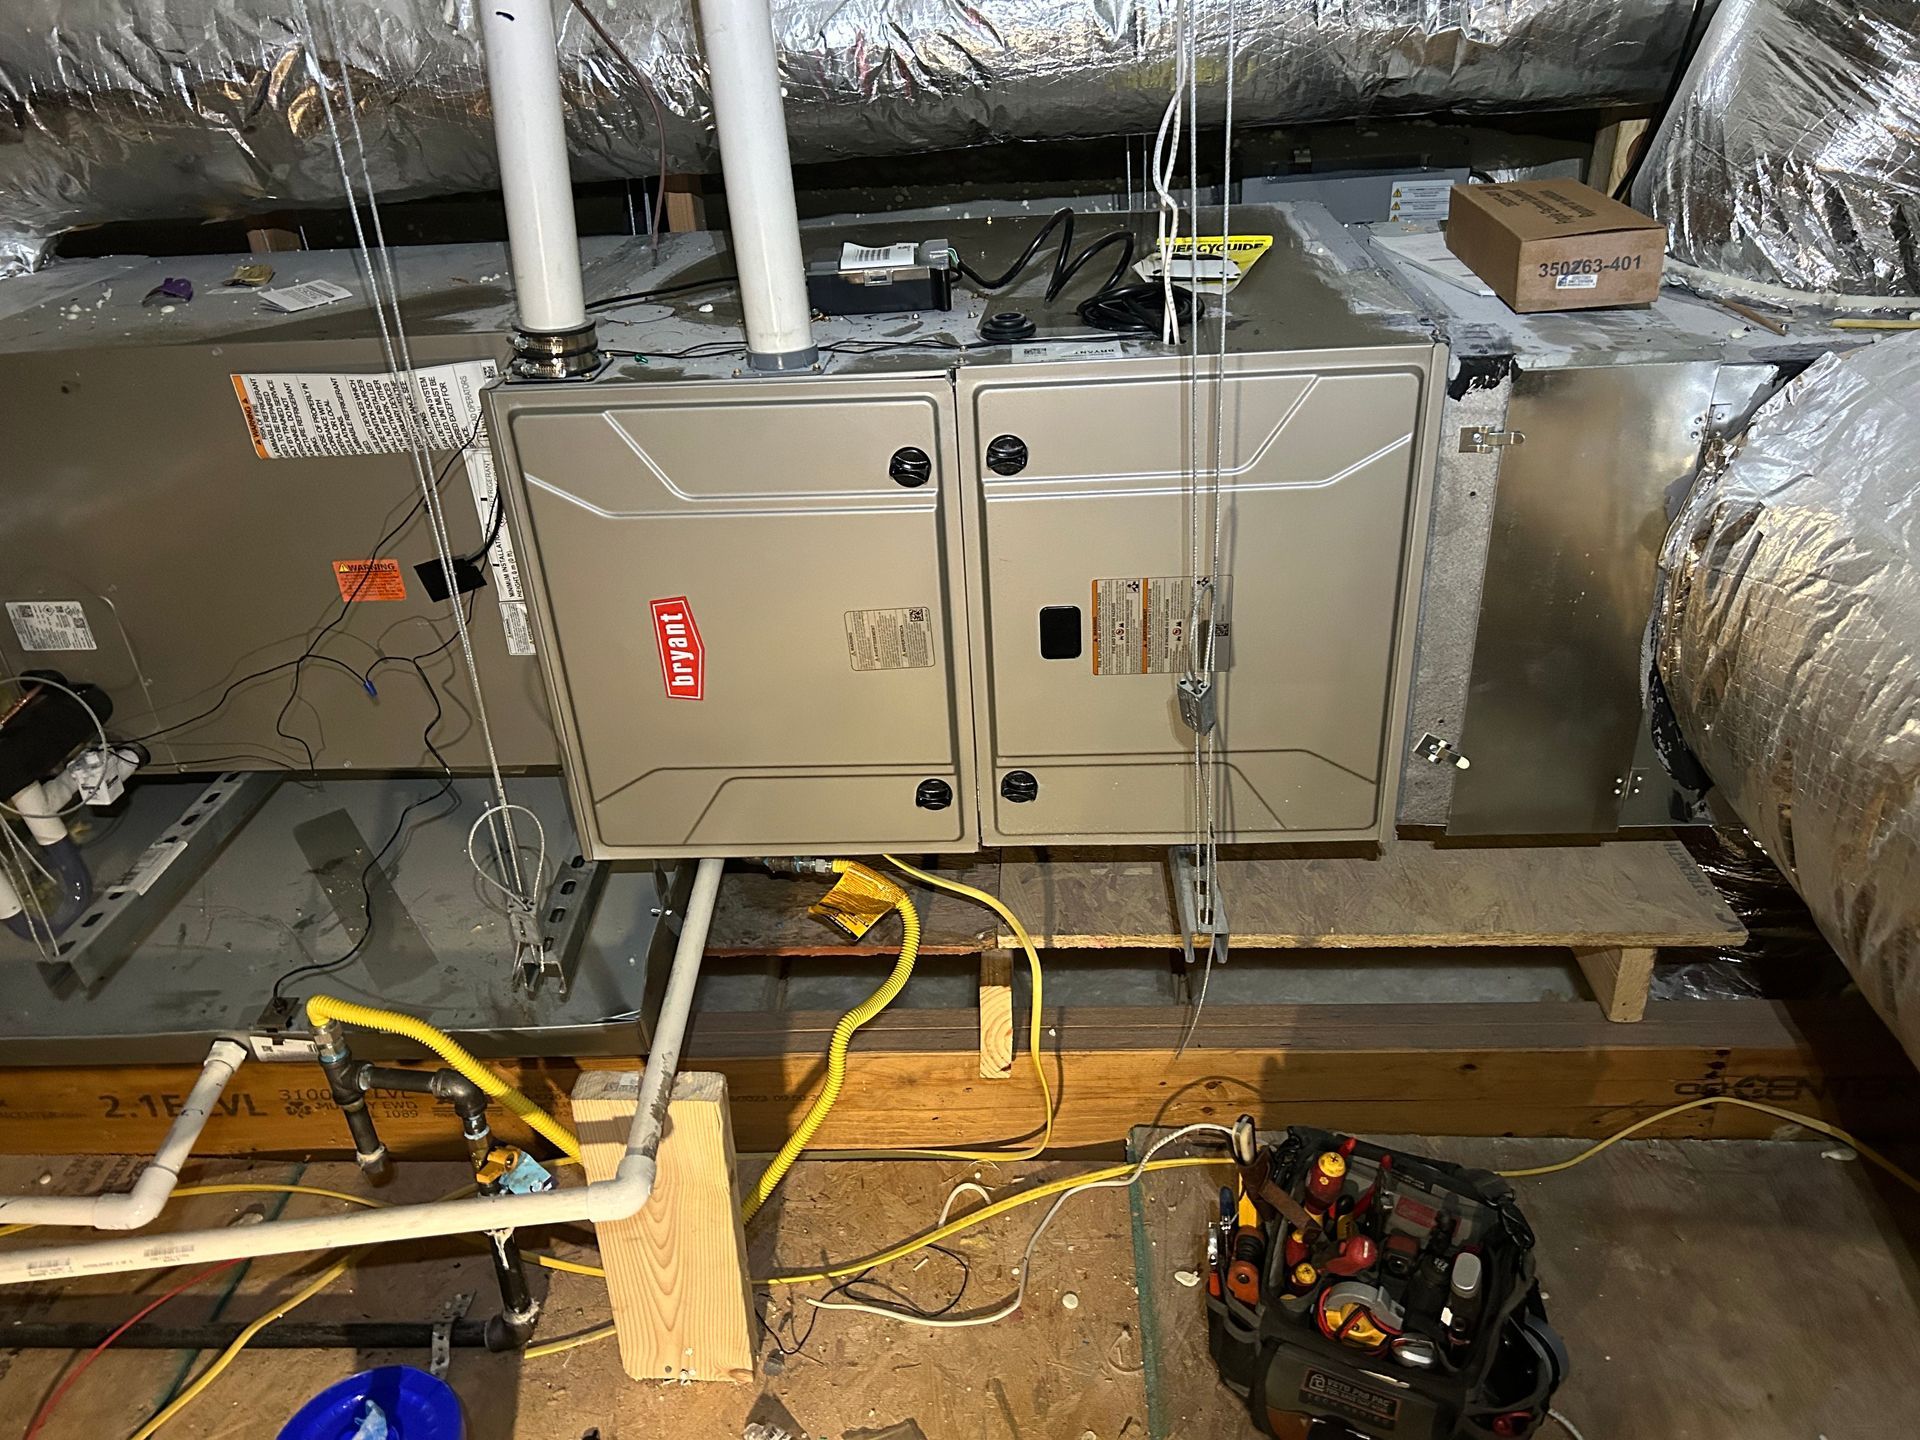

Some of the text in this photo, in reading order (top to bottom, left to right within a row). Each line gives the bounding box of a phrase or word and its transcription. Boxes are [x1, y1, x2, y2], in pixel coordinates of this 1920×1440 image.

[1156, 243, 1264, 253] EERGYGUIDE
[1538, 255, 1641, 278] 350263-401
[267, 380, 280, 406] SERVICE
[349, 380, 361, 401] WHICH
[373, 380, 385, 401] OTHER
[400, 381, 409, 393] SEE
[420, 377, 432, 403] SYSTEM
[429, 377, 436, 385] BE
[440, 382, 448, 396] FOR
[281, 397, 289, 410] NOT
[283, 383, 303, 426] REFRIGERANT
[330, 377, 351, 420] REFRIGERANT
[357, 380, 372, 409] SOURCES
[366, 383, 383, 415] INSTALLED
[383, 383, 397, 408] DEVICES
[432, 387, 442, 405] MUST
[460, 376, 476, 412] OPERATORS
[250, 378, 282, 456] LAMMABLE REFRIGERANT
[263, 392, 277, 423] REPAIRED
[286, 412, 293, 421] DO
[304, 390, 319, 423] PROPERLY
[315, 400, 325, 415] WITH
[324, 399, 335, 420] LOCAL
[357, 402, 371, 427] DEVICES
[438, 407, 446, 420] UNIT
[443, 398, 456, 422] EXCEPT
[245, 407, 259, 437] WARNING
[274, 424, 281, 432] BE
[277, 408, 289, 434] TRAINED
[315, 424, 323, 433] OF
[331, 421, 338, 430] OR
[368, 410, 382, 434] IGNITION
[382, 425, 391, 436] NOT
[428, 405, 444, 436] DETECTION
[285, 436, 293, 444] BY
[495, 534, 514, 597] MINIMUM INSTALLATIO
[660, 613, 695, 686] bryant
[98, 1094, 184, 1118] 2.1E
